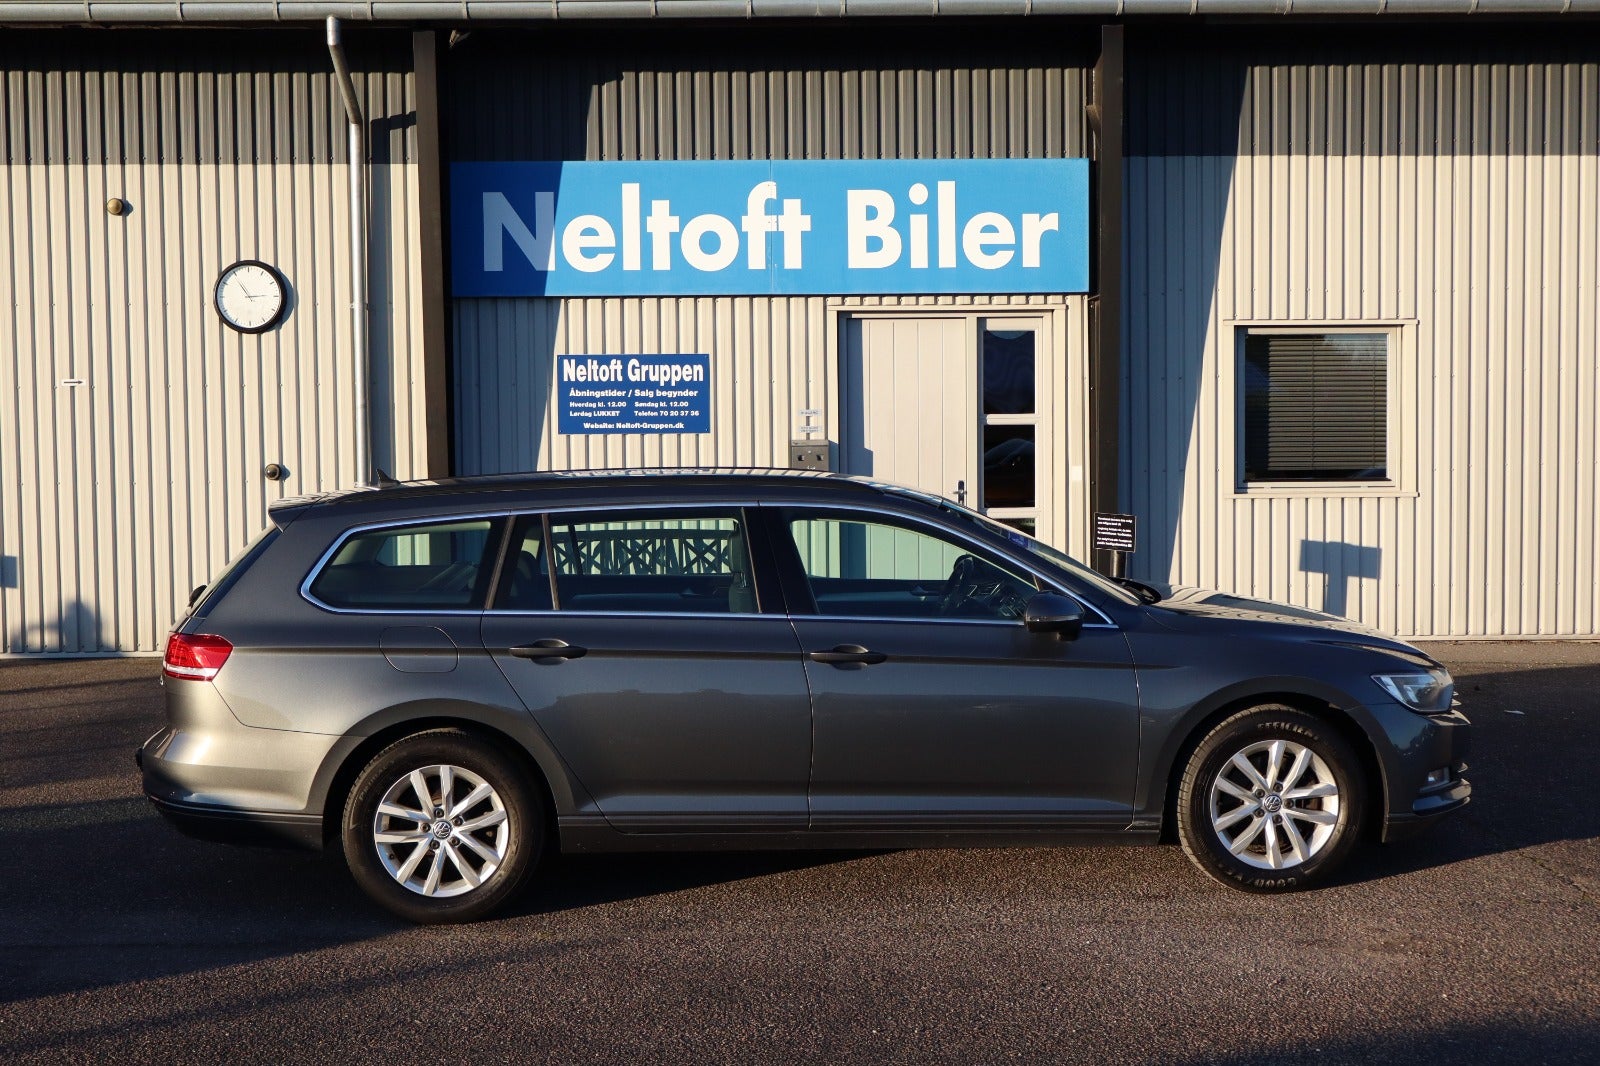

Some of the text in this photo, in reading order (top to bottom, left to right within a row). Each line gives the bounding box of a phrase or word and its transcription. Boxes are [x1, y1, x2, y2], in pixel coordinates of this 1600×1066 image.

[482, 180, 1060, 273] Neltoft Biler
[563, 359, 704, 386] Neltoft Gruppen
[569, 387, 626, 398] Åbningstider
[634, 389, 654, 397] Salg
[656, 389, 698, 398] begynder
